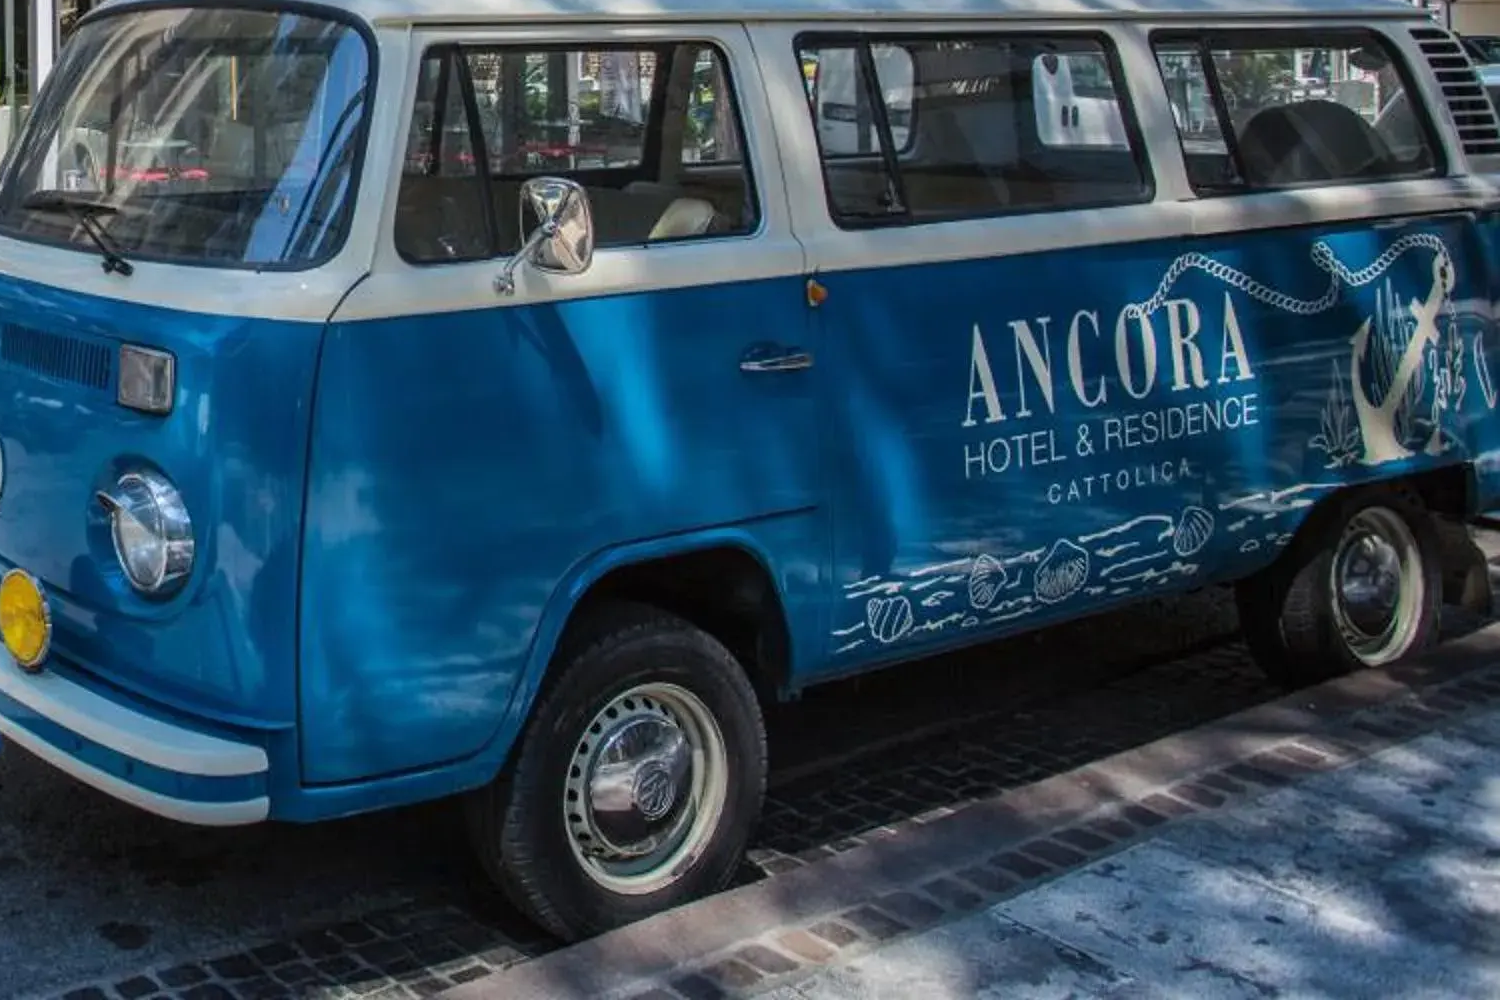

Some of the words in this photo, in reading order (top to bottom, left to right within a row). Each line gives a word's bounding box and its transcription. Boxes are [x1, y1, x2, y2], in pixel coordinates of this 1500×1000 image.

[961, 291, 1255, 427] ANCORA
[963, 430, 1067, 479] HOTEL
[1076, 423, 1095, 457] &
[1104, 393, 1260, 451] RESIDENCE
[1047, 457, 1192, 505] CATTOLICA
